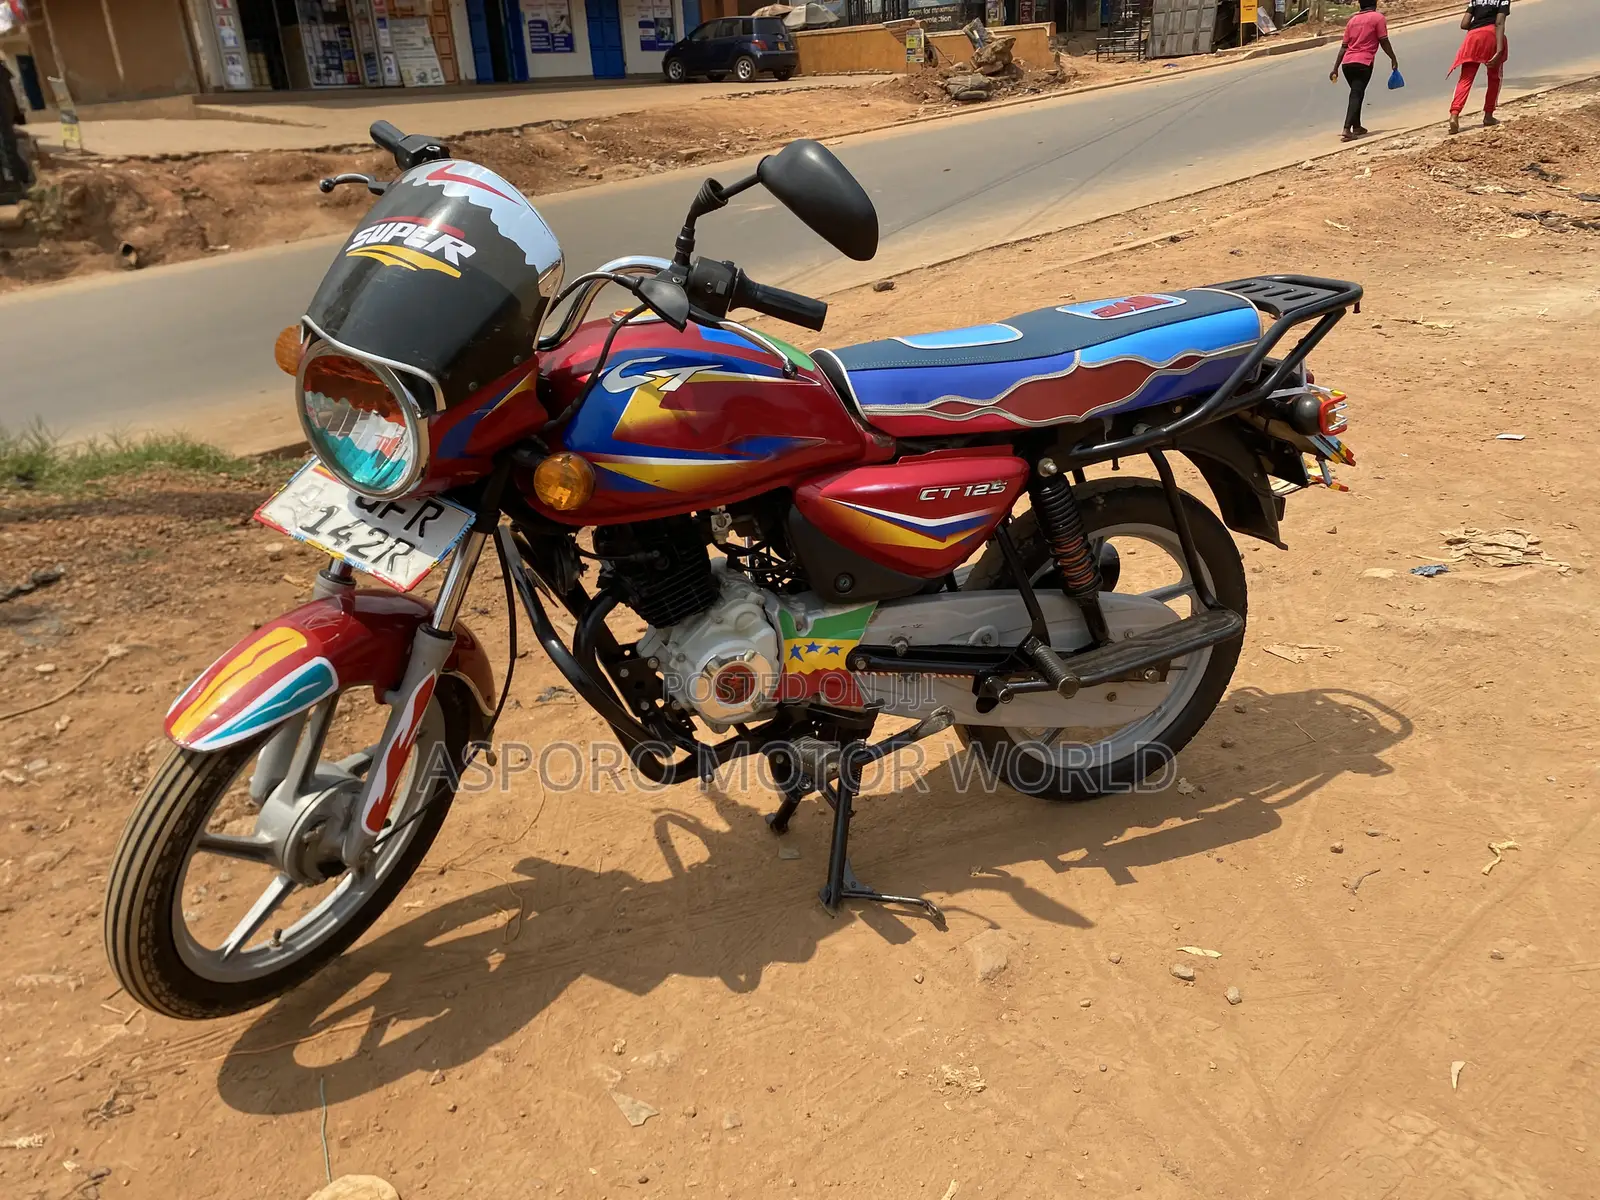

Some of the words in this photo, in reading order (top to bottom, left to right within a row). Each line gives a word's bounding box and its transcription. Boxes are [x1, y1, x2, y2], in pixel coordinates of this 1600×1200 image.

[346, 222, 476, 266] SUPER
[601, 355, 723, 394] CT
[920, 487, 960, 501] CT
[964, 481, 1007, 497] 125
[300, 506, 415, 572] 142R
